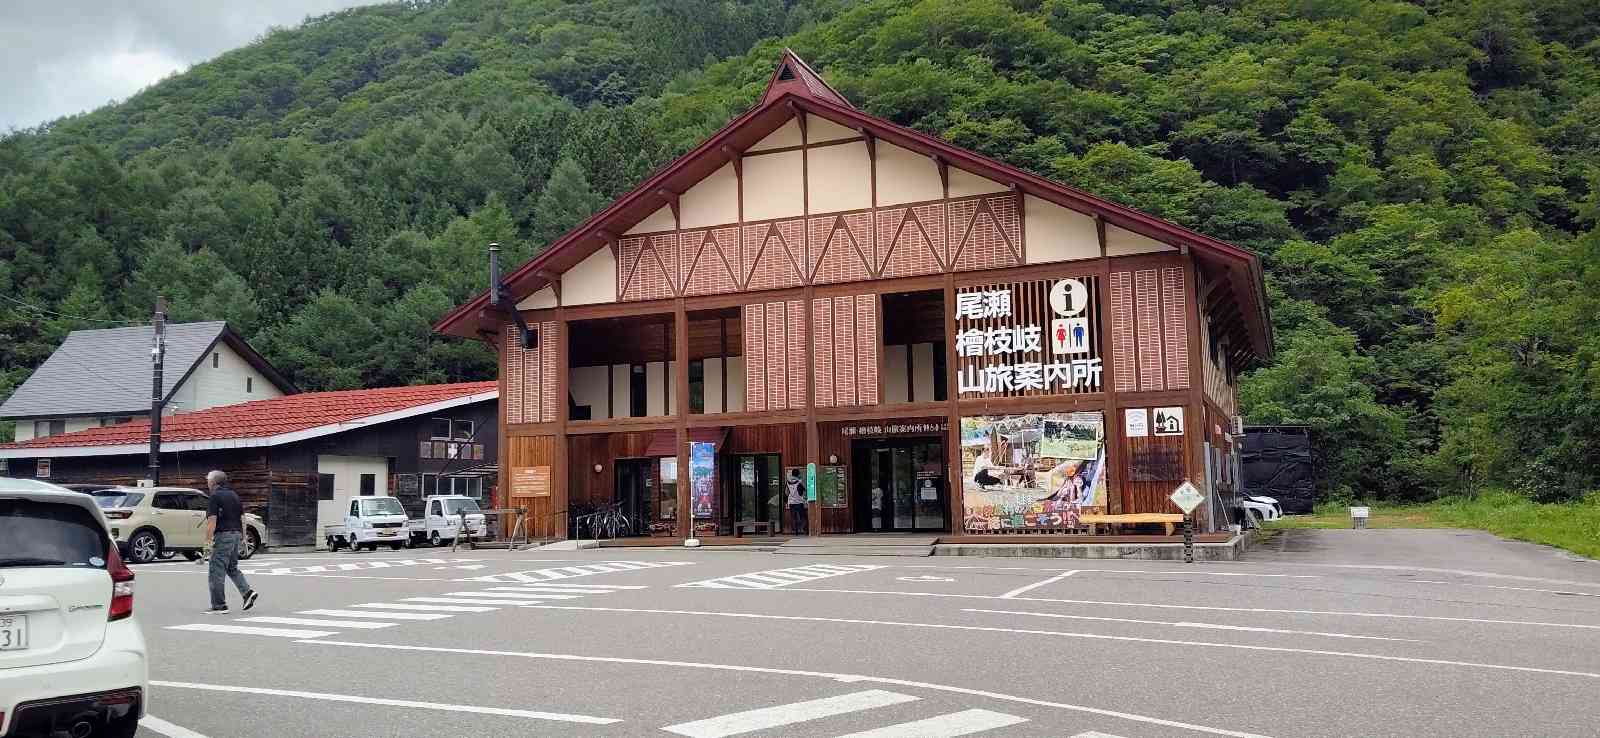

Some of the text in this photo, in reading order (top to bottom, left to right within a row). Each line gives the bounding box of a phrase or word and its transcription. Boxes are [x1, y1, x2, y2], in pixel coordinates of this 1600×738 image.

[955, 290, 1012, 321] 尾瀬
[955, 324, 1042, 357] 檜枝岐
[957, 358, 1103, 394] 山旅案内所
